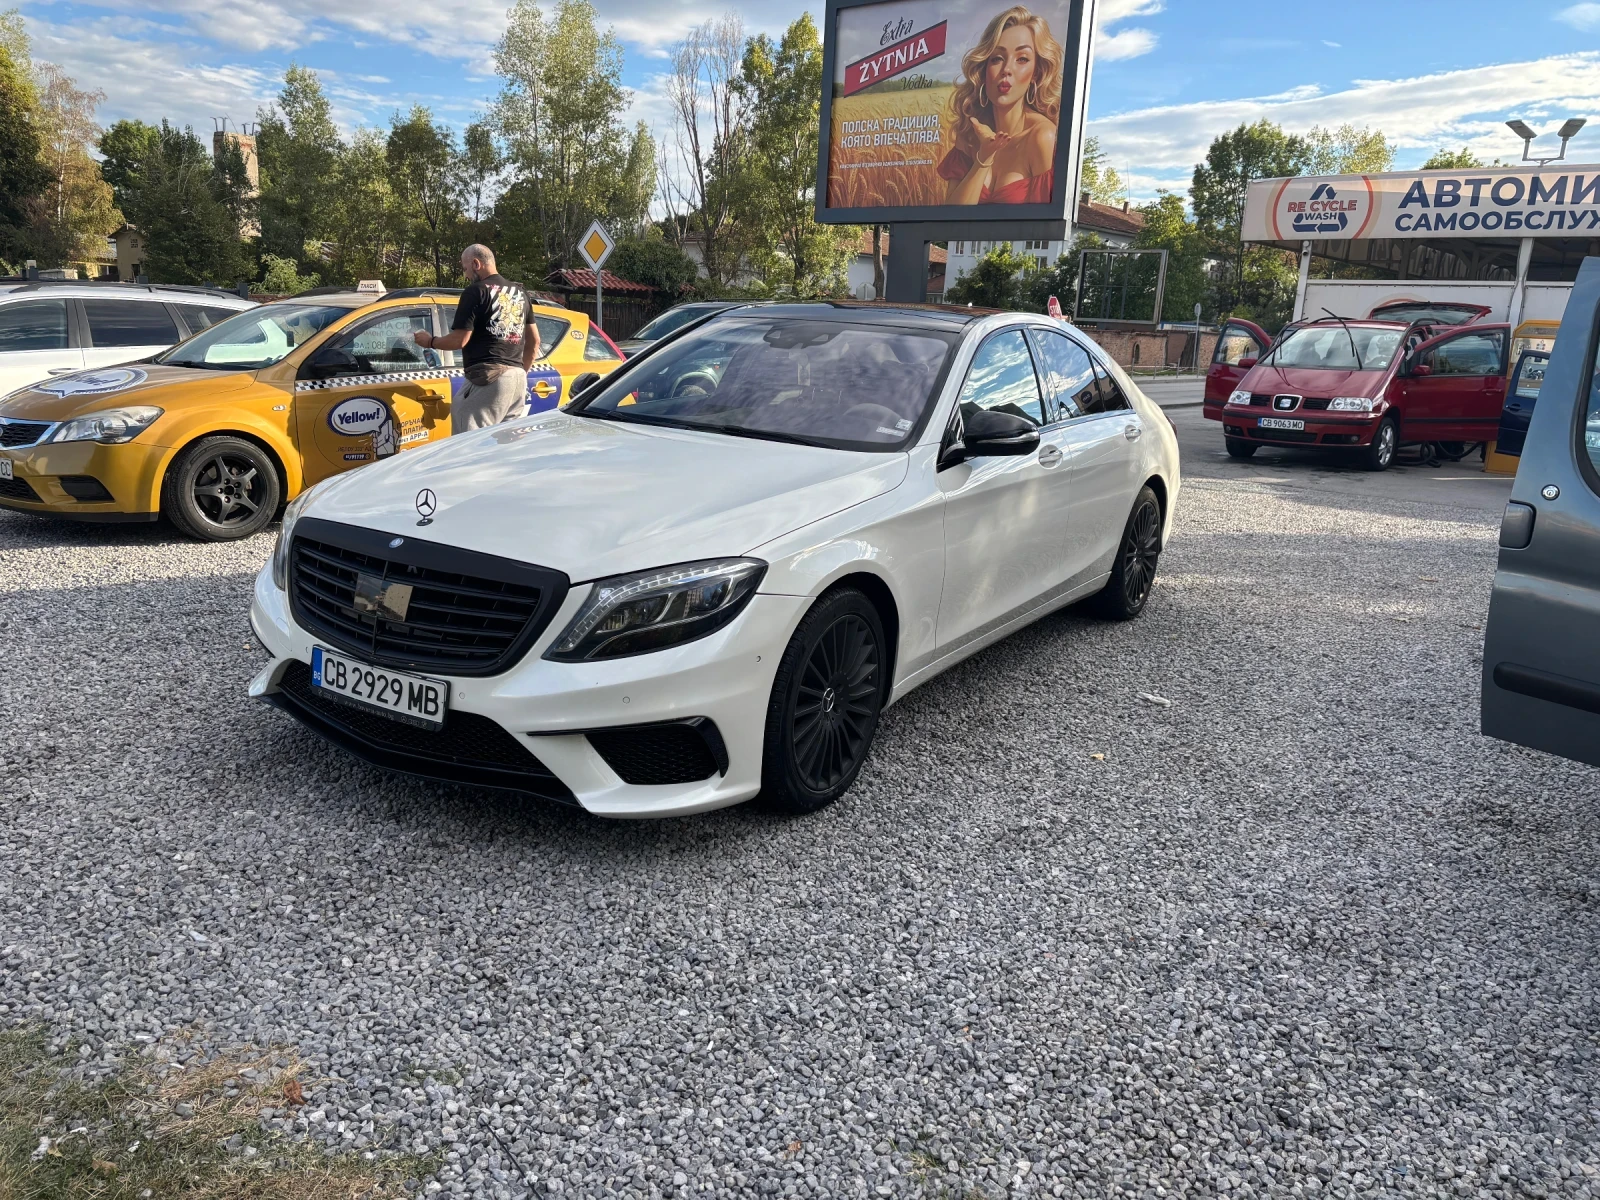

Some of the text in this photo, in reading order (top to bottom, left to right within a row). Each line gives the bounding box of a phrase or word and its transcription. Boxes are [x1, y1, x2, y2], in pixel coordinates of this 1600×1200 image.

[880, 16, 914, 46] Extra
[859, 37, 930, 84] ŻYTNIA
[901, 73, 933, 90] Vodka
[841, 114, 941, 134] ПОЛСКА ТРАДИЦИЯ,
[840, 129, 940, 149] КОЯТО ВПЕЧАТЛЯВА
[1287, 200, 1358, 213] RE CYCLE
[1304, 212, 1338, 221] WASH
[338, 408, 380, 425] Yellow!
[1262, 418, 1272, 427] CB
[1273, 419, 1291, 429] 9063
[313, 657, 439, 716] BG CB 2929 MB
